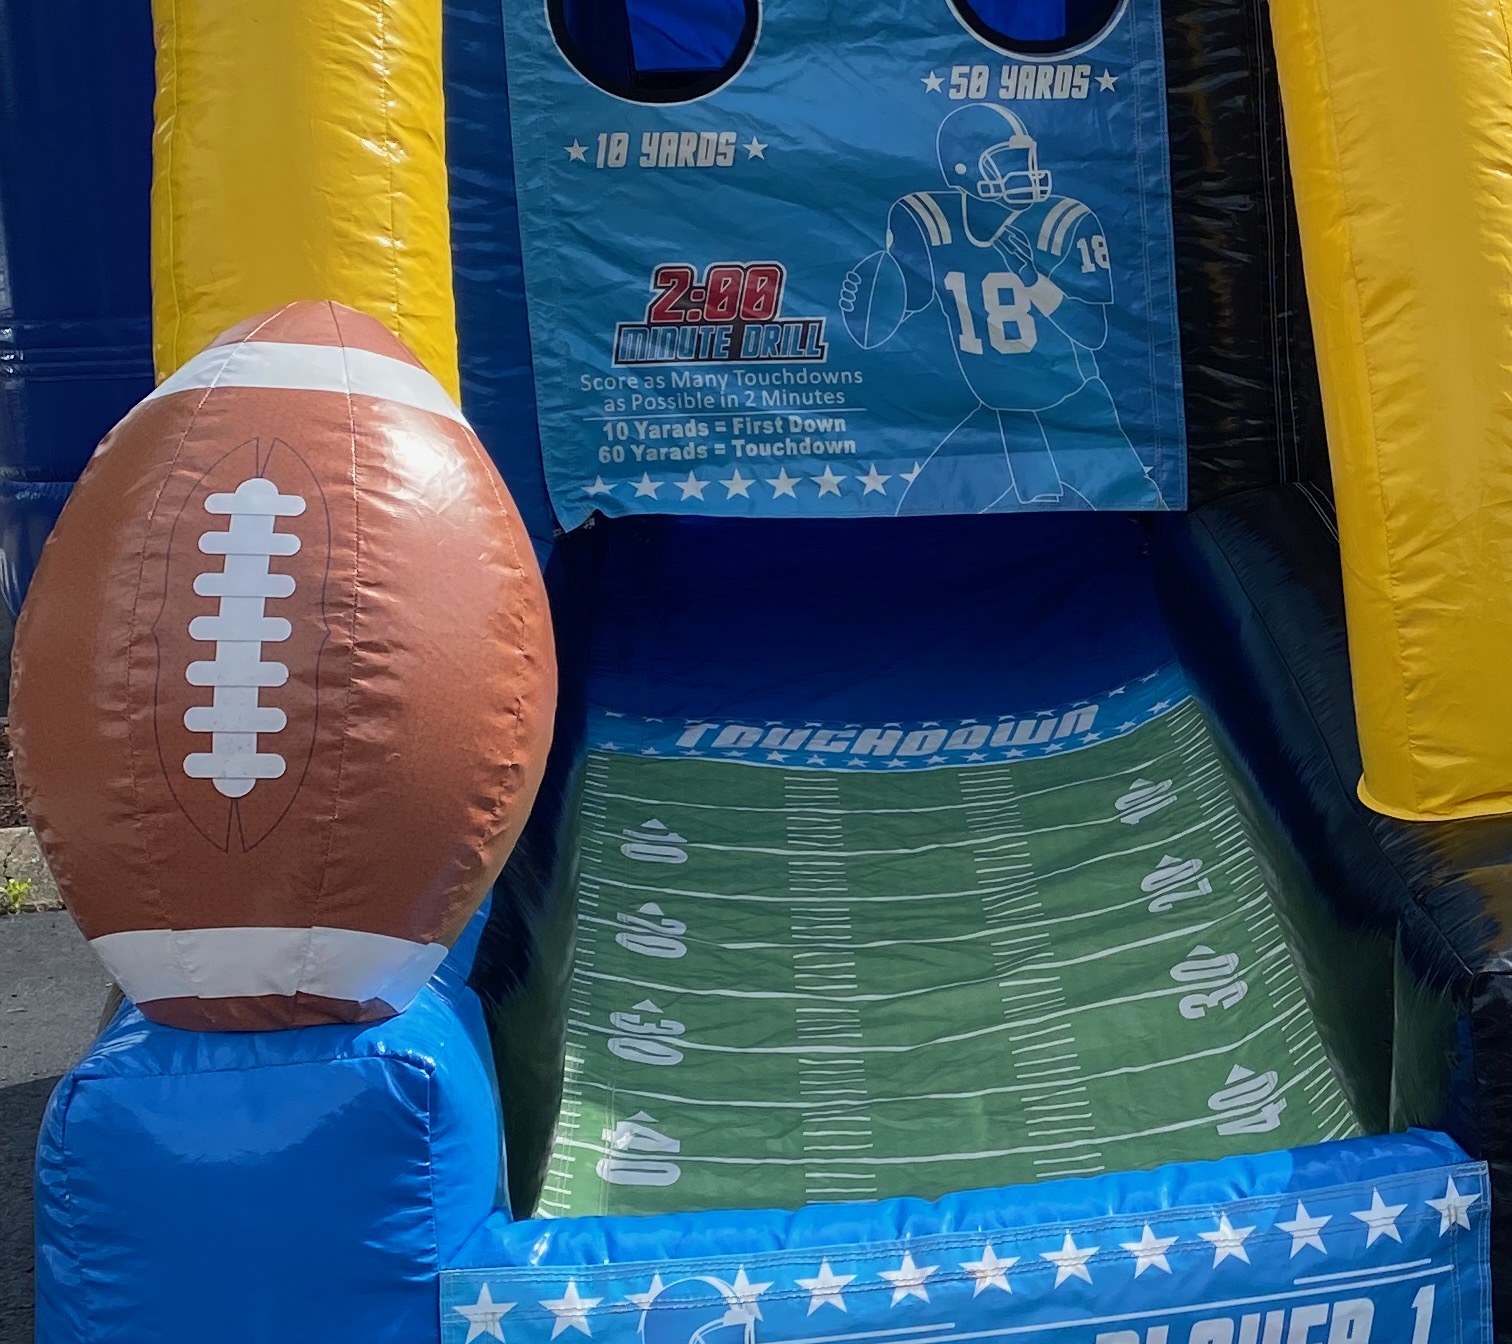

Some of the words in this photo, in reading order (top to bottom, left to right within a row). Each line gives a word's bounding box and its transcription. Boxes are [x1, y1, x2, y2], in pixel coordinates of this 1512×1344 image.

[948, 65, 987, 100] 50
[1000, 64, 1091, 99] YARDS
[596, 132, 629, 169] 10
[639, 131, 737, 167] YARDS
[1077, 234, 1109, 273] 18
[650, 266, 781, 324] 2:00
[944, 271, 1036, 356] 18
[617, 325, 733, 361] MINUTE
[740, 323, 824, 358] DRILL
[580, 372, 638, 392] Score
[643, 377, 666, 389] as
[671, 371, 728, 390] Many
[735, 367, 863, 387] Touchdowns
[604, 397, 630, 413] as
[632, 391, 715, 411] Possible
[720, 391, 739, 408] in
[744, 390, 757, 407] 2
[762, 389, 845, 407] Minutes
[598, 445, 625, 464] 60
[630, 441, 709, 462] Yarads
[731, 437, 856, 458] Touchdown
[603, 421, 628, 442] 10
[633, 418, 709, 440] Yarads
[732, 416, 783, 436] First
[789, 415, 846, 435] Down
[675, 704, 1099, 756] TOUCHDOWN
[1115, 779, 1177, 824] 10
[620, 828, 688, 864] 10
[1141, 858, 1212, 913] 20
[615, 912, 687, 958] 20
[1169, 952, 1248, 1019] 30
[607, 1011, 686, 1065] 30
[1208, 1070, 1287, 1136] 40
[595, 1120, 682, 1187] 40
